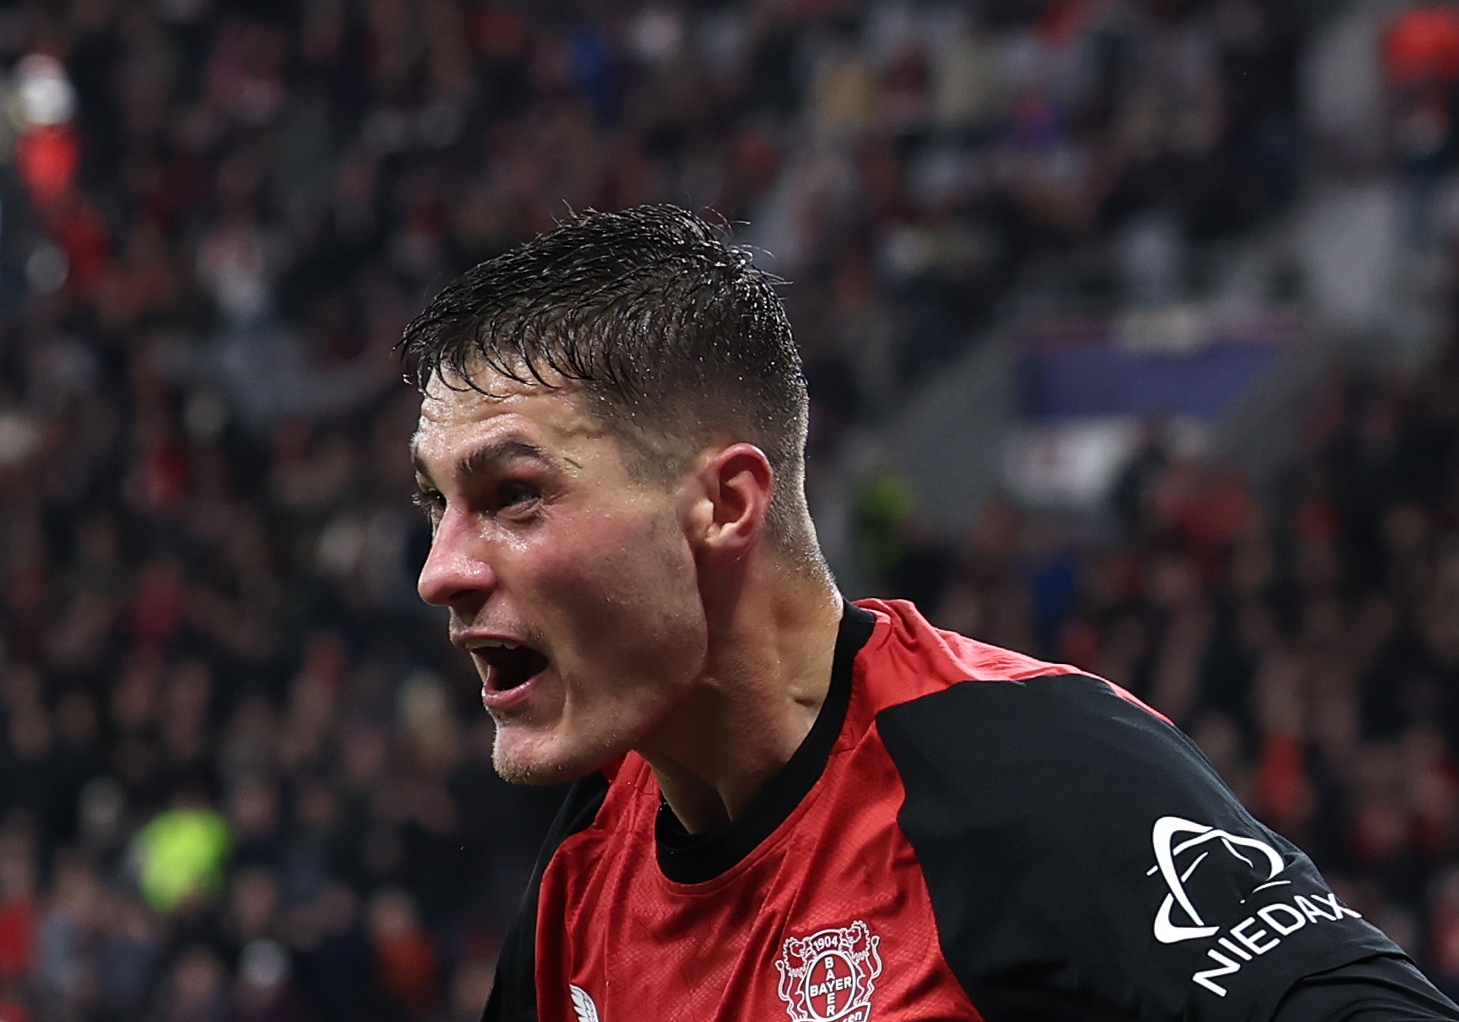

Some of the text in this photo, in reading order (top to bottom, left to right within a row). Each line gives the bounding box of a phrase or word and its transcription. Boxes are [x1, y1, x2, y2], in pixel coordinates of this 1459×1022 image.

[813, 935, 839, 952] 1904
[1192, 893, 1362, 998] NIEDAX
[809, 976, 853, 998] BAYER
[824, 956, 836, 1017] BAYER
